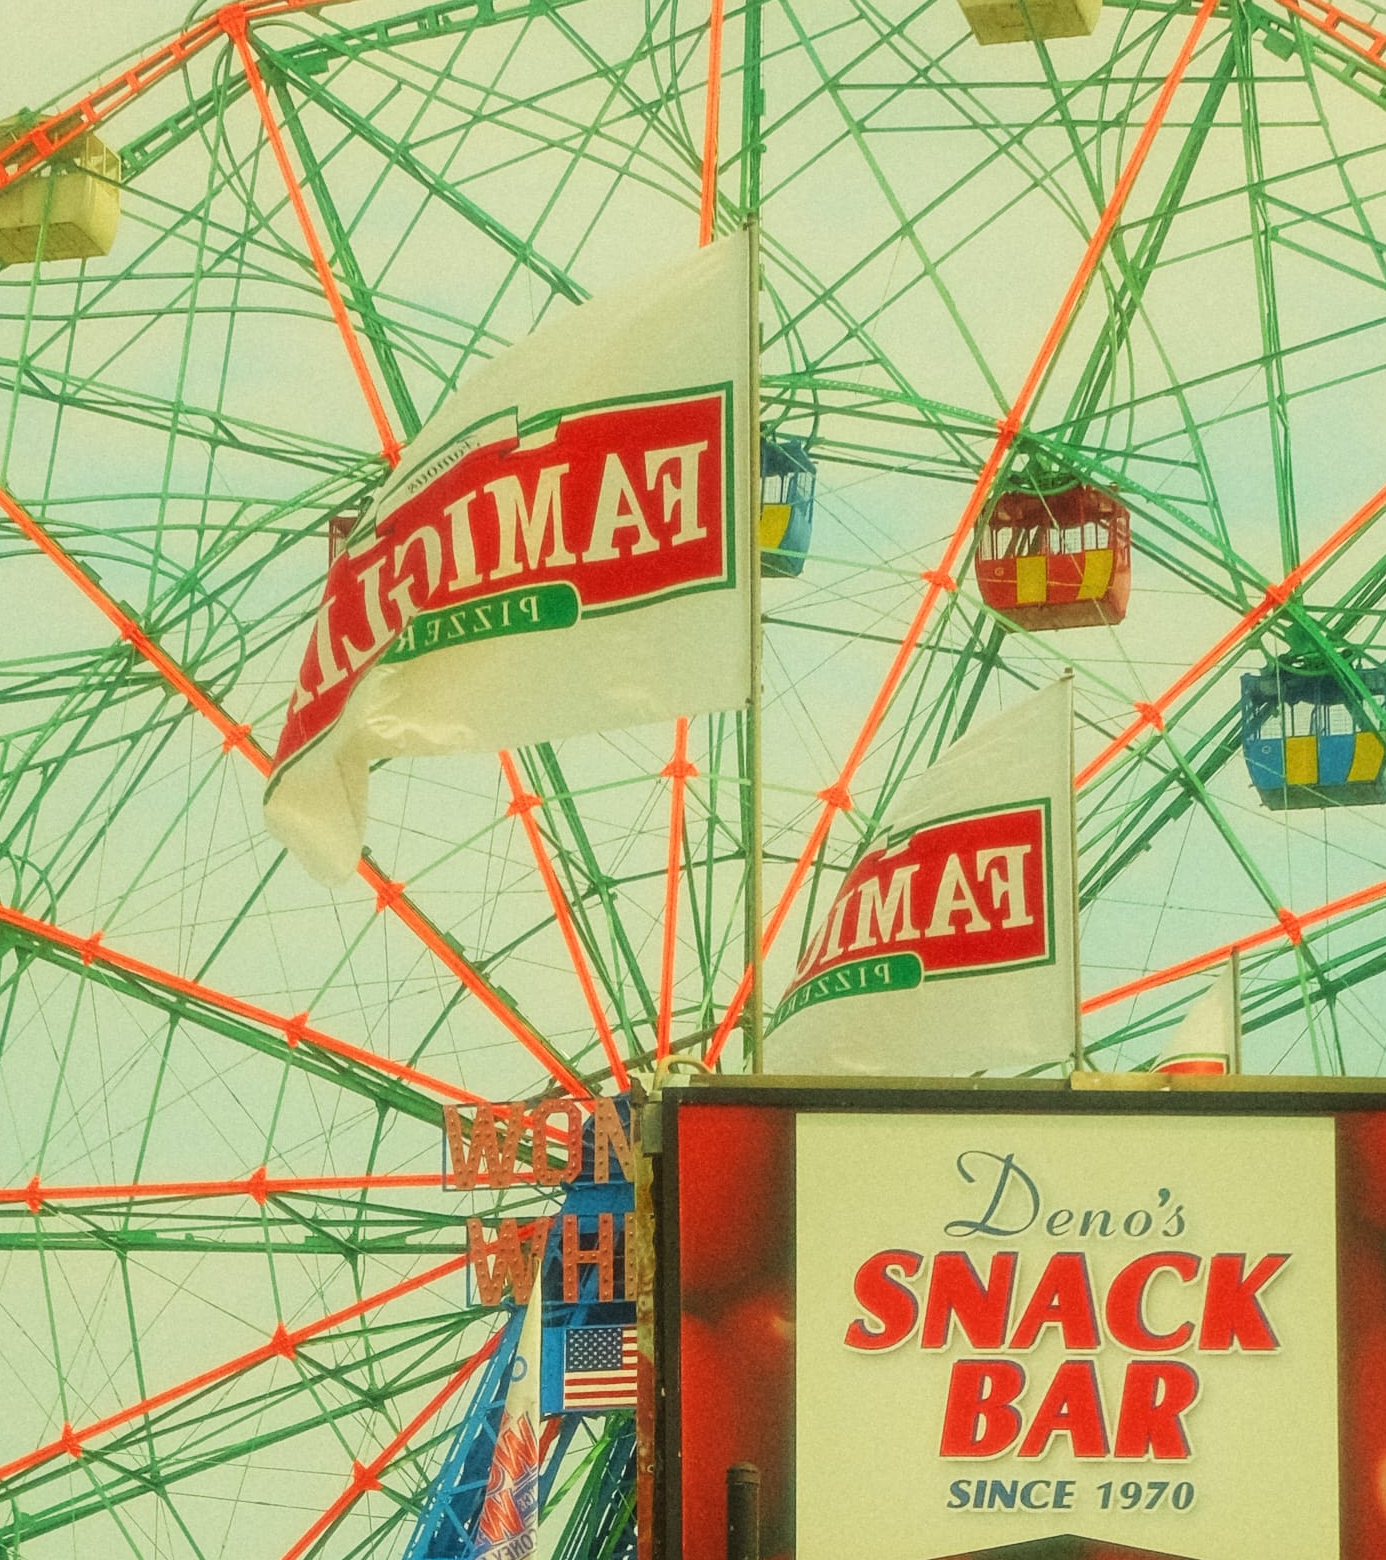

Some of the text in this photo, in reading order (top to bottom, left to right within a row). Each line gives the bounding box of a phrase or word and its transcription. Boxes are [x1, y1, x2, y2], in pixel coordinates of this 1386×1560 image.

[944, 1150, 1186, 1239] Deno's
[843, 1249, 1292, 1352] SNACK
[939, 1359, 1200, 1460] BAR
[947, 1479, 1195, 1511] SINCE 1970
